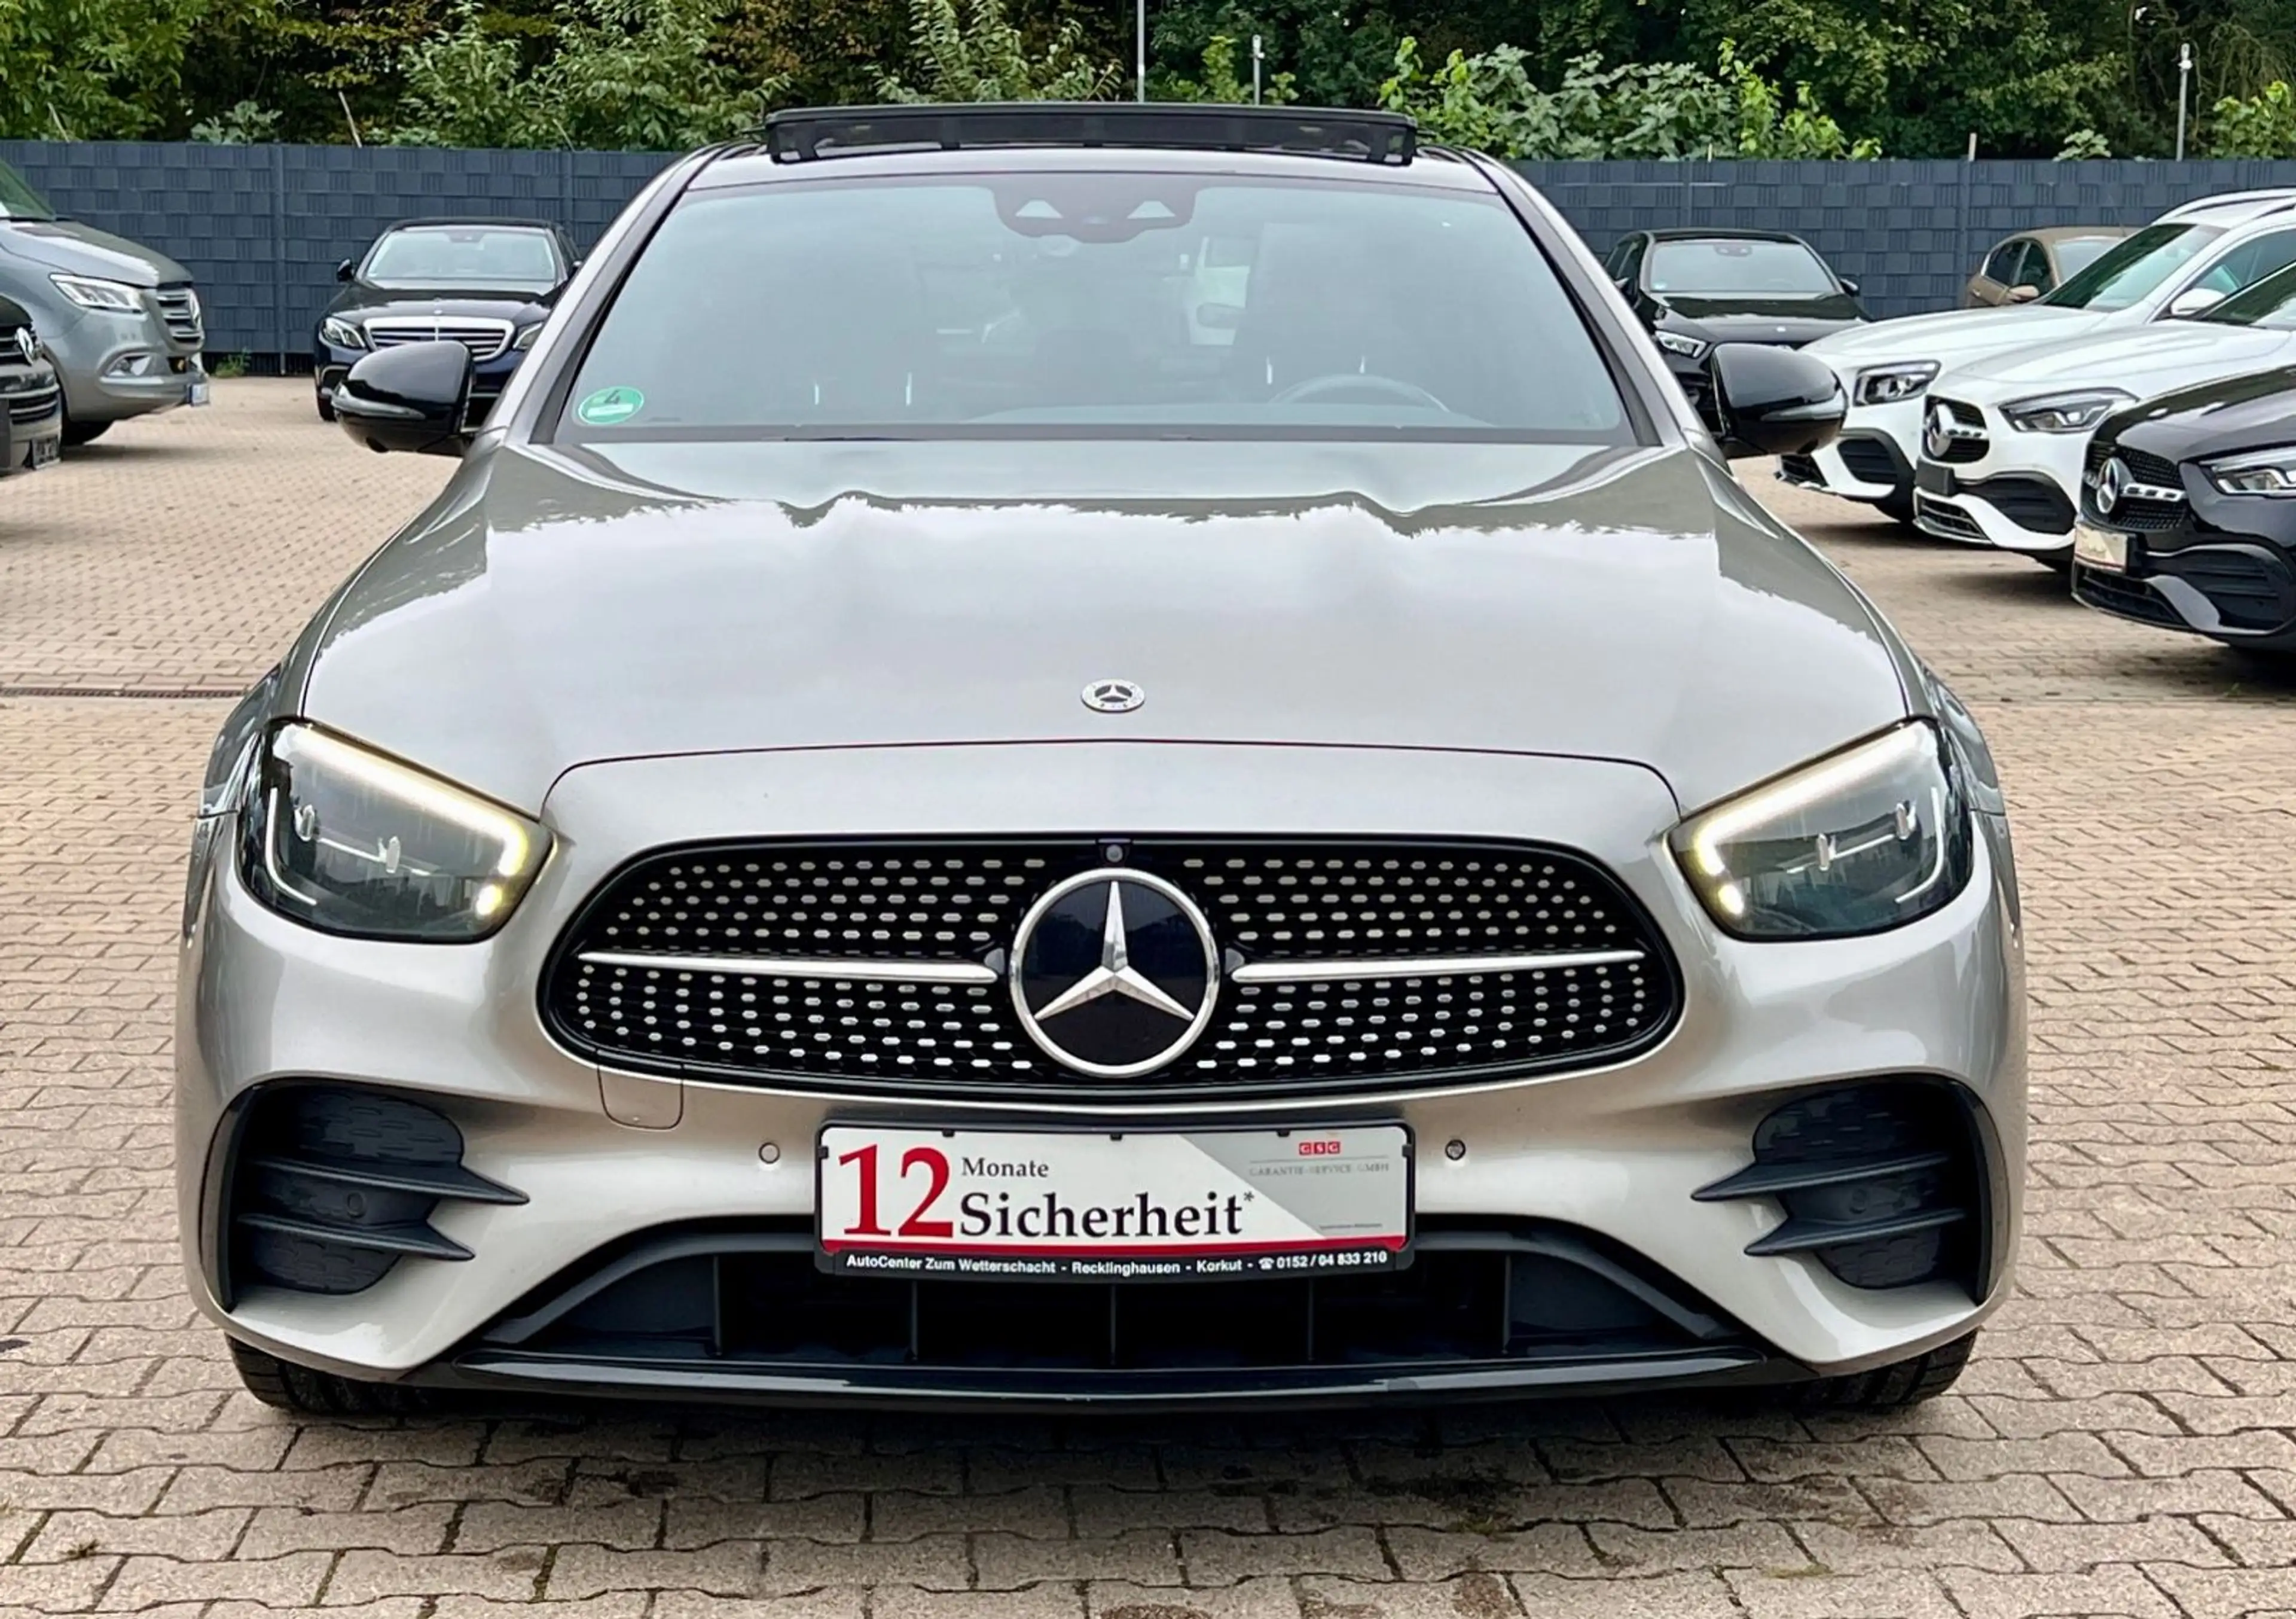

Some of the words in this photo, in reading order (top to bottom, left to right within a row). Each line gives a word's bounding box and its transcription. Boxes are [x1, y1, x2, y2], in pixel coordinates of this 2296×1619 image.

[604, 390, 621, 404] 4
[961, 1157, 1049, 1178] Monate
[839, 1144, 954, 1237] 12
[847, 1254, 923, 1270] AutoCenter
[925, 1257, 955, 1271] Zum
[958, 1258, 1056, 1274] Wetterschacht
[1071, 1261, 1181, 1277] Recklinghausen
[1196, 1259, 1243, 1273] Korkut
[1276, 1256, 1308, 1269] 0152
[1337, 1252, 1361, 1266] 833
[1363, 1250, 1388, 1264] 210
